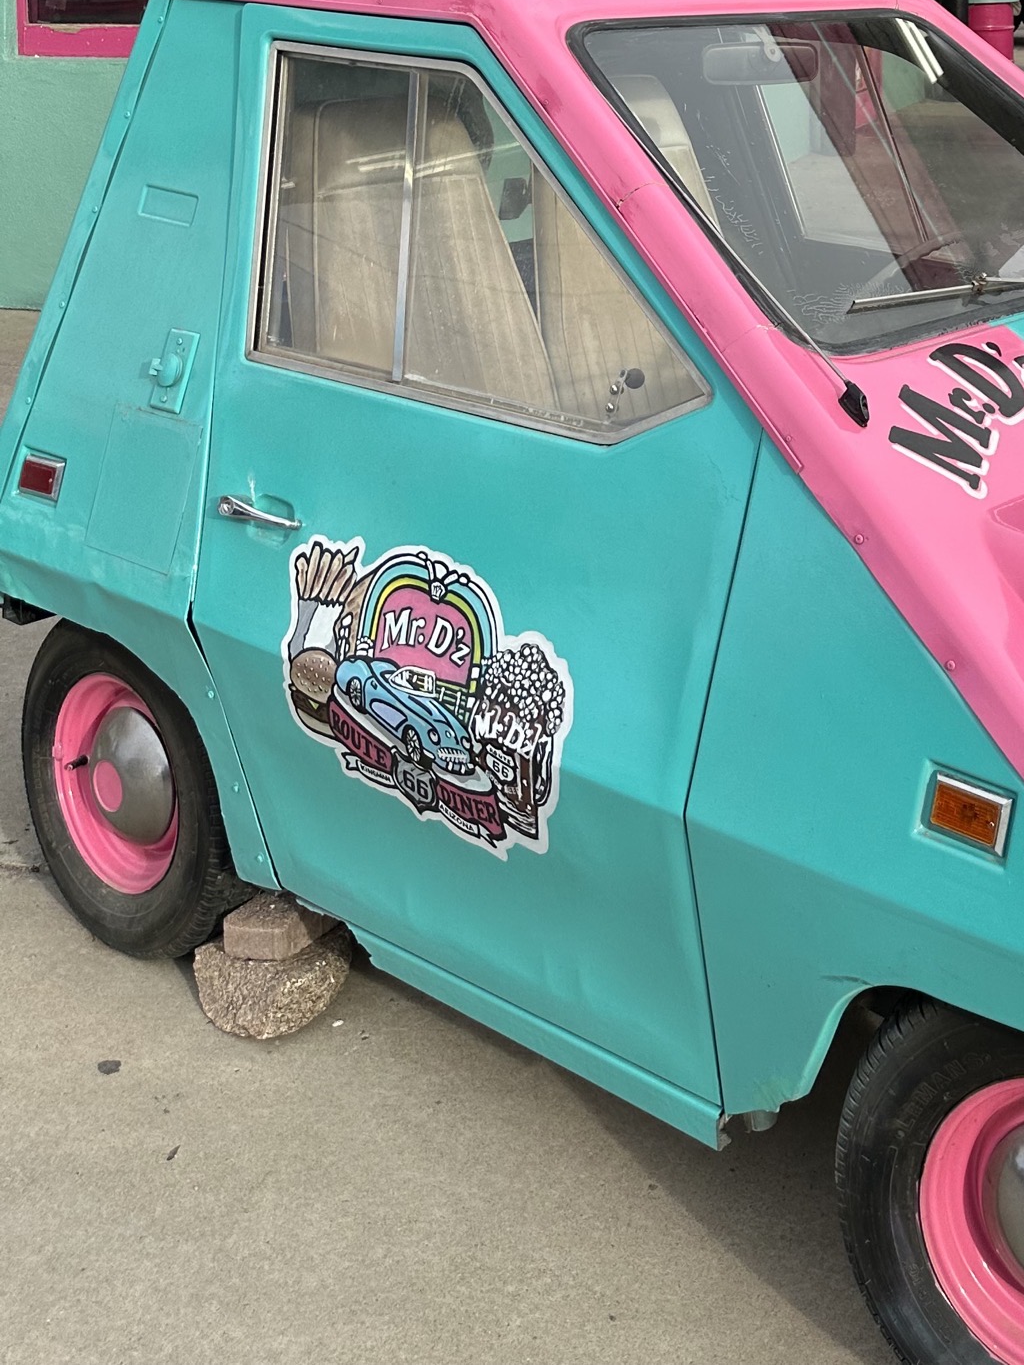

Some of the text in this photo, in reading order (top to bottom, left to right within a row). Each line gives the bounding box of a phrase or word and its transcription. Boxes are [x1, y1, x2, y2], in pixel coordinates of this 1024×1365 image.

[331, 709, 500, 826] ROUTE 66 DINER
[492, 761, 510, 778] 66
[440, 804, 475, 832] ARIZONA
